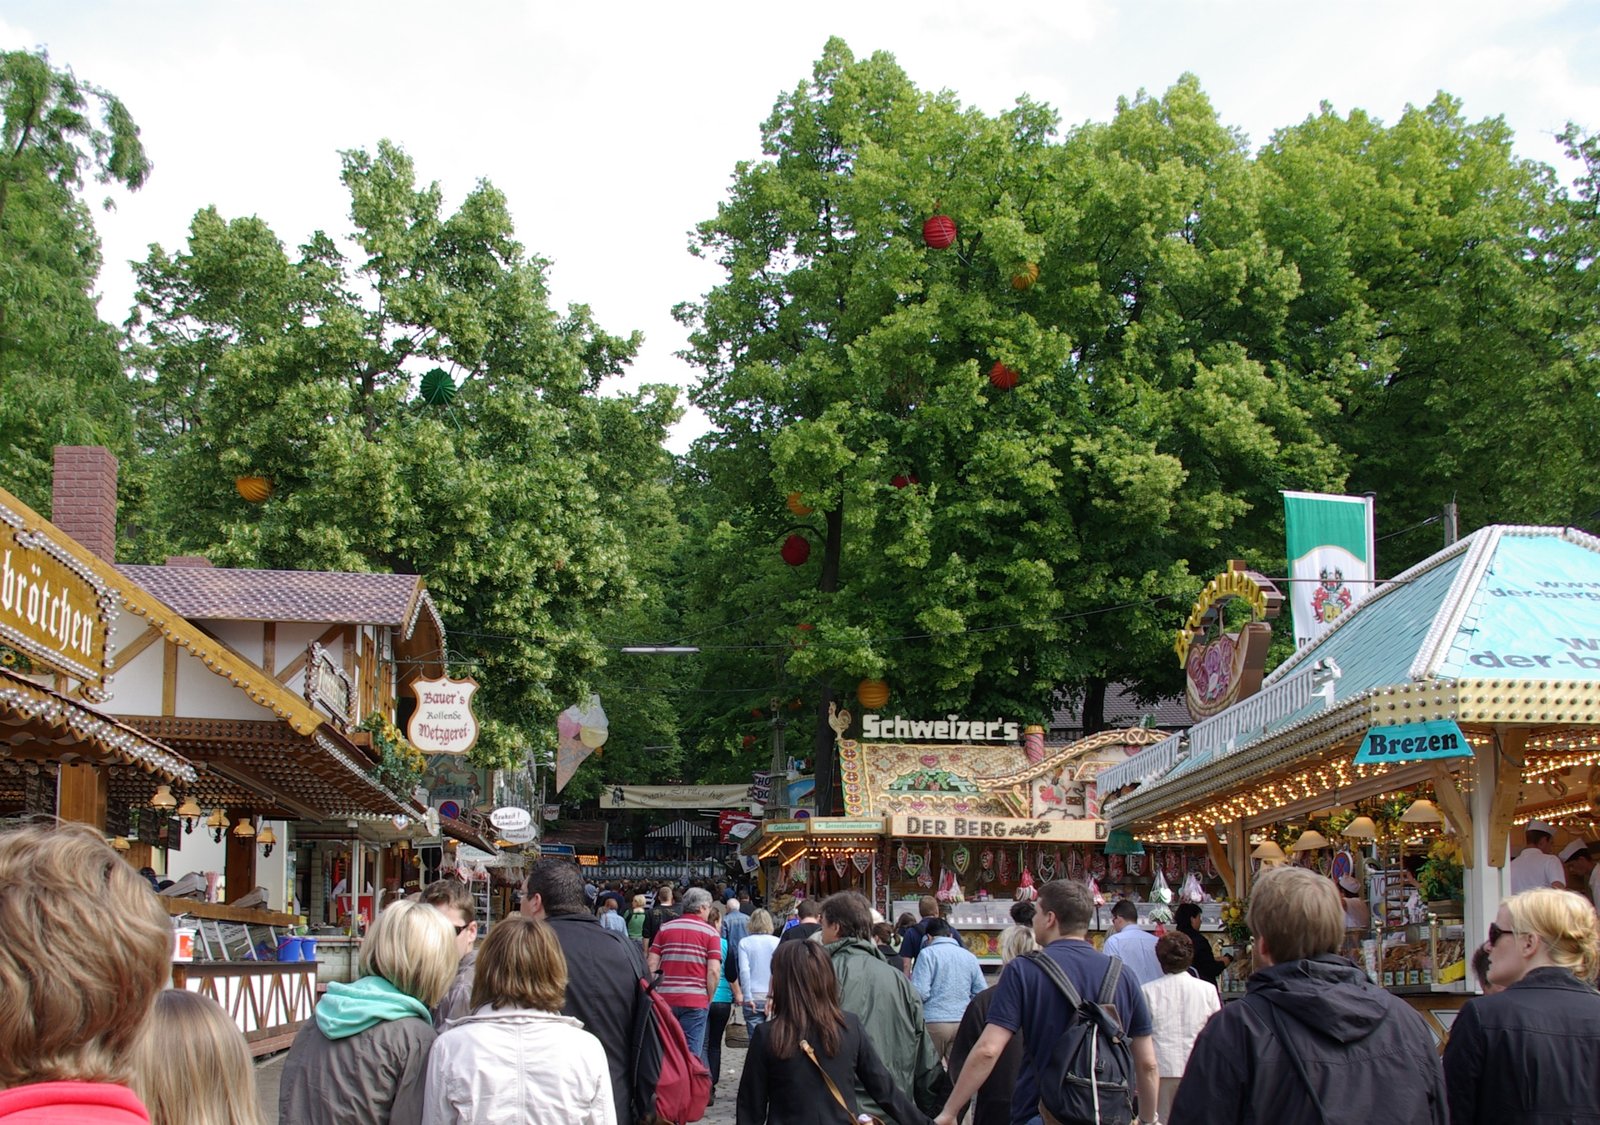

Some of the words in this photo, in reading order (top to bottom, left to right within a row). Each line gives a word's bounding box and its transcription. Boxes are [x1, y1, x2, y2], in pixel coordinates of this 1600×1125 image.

[2, 550, 94, 657] brötchen
[423, 691, 466, 705] Bauer's
[426, 710, 462, 720] Rollende
[862, 713, 1019, 741] Schweizer's
[1368, 731, 1459, 757] Brezen
[907, 816, 948, 836] DER
[954, 818, 1006, 837] BERG
[1008, 820, 1053, 838] ruft
